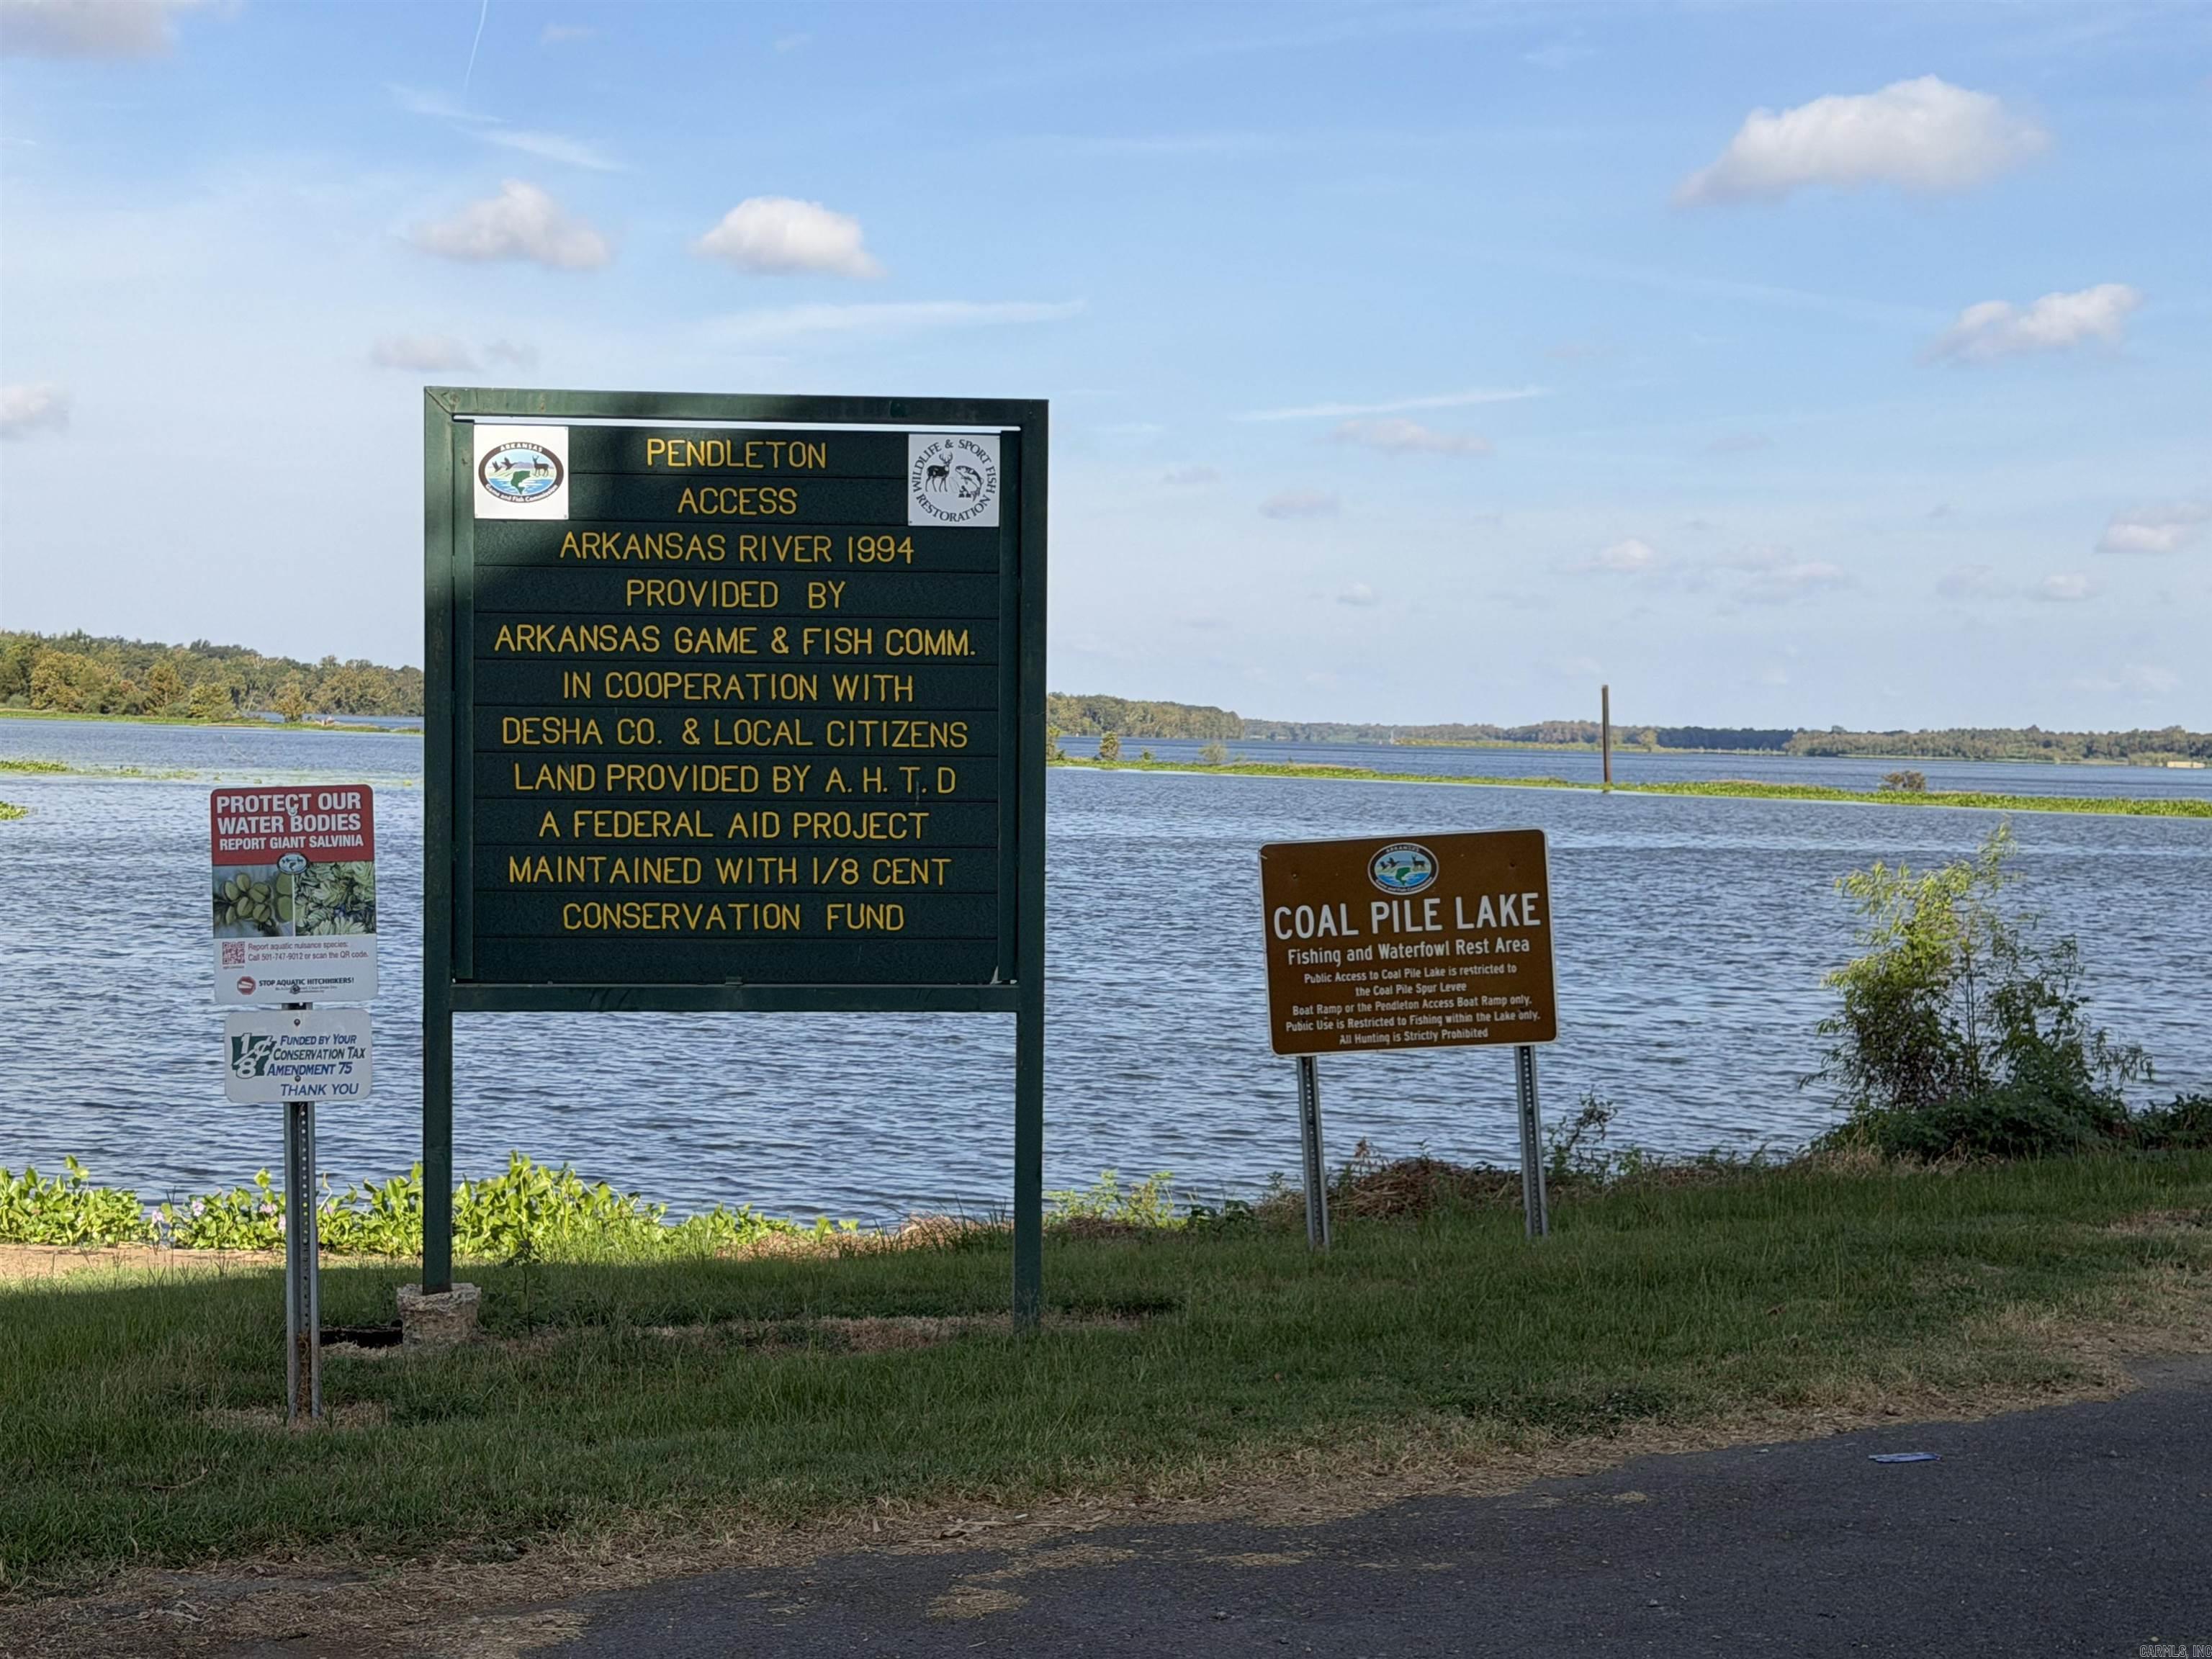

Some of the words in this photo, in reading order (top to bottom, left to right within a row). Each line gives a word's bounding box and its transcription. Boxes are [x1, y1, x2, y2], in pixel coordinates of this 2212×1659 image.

[500, 442, 544, 452] ARKANSAS
[647, 438, 827, 469] PENDLETON
[912, 441, 942, 493] WILDLIFE
[944, 439, 954, 449] &
[958, 439, 992, 464] SPORT
[985, 465, 997, 494] FISH
[678, 487, 798, 516] ACCESS
[916, 493, 991, 522] RESTORATION
[560, 531, 727, 562] ARKANSAS
[739, 535, 832, 564] RIVER
[848, 536, 914, 564] 1994
[626, 579, 779, 608] PROVIDED
[807, 581, 846, 610] BY
[494, 624, 661, 653] ARKANSAS
[673, 626, 757, 655] GAME
[770, 627, 790, 655] &
[802, 627, 873, 655] FISH
[886, 629, 976, 657] COMM.
[563, 672, 591, 699] IN
[605, 672, 818, 701] COOPERATION
[832, 674, 914, 702] WITH
[502, 716, 603, 745] DESHA
[617, 718, 662, 745] CO.
[681, 718, 701, 746] &
[714, 719, 814, 747] LOCAL
[826, 720, 968, 749] CITIZENS
[514, 763, 596, 792] LAND
[606, 764, 760, 793] PROVIDED
[773, 765, 811, 793] BY
[825, 768, 853, 793] A.
[863, 768, 889, 793] H.
[899, 767, 927, 794] T.
[937, 767, 957, 794] D
[217, 793, 312, 814] PROTECT
[318, 792, 361, 811] OUR
[217, 816, 284, 835] WATER
[290, 813, 361, 832] BODIES
[538, 811, 561, 838] A
[573, 810, 714, 839] FEDERAL
[727, 811, 781, 839] AID
[793, 811, 930, 840] PROJECT
[220, 837, 266, 850] REPORT
[269, 836, 306, 849] GIANT
[309, 835, 364, 848] SALVINIA
[508, 855, 703, 884] MAINTAINED
[715, 857, 798, 885] WITH
[812, 858, 860, 886] 1/8
[871, 858, 952, 886] CENT
[562, 902, 801, 931] CONSERVATION
[826, 903, 906, 932] FUND
[1273, 903, 1359, 940] COAL
[1370, 897, 1443, 934] PILE
[1455, 892, 1541, 930] LAKE
[270, 942, 293, 950] aquatic
[1287, 947, 1341, 968] Fishing
[1346, 945, 1373, 962] and
[1377, 940, 1450, 960] Waterfowl
[1455, 938, 1490, 956] Rest
[1495, 936, 1530, 954] Area
[1303, 973, 1332, 984] Public
[1335, 971, 1367, 982] Access
[1370, 970, 1379, 980] to
[1381, 969, 1401, 979] Coal
[1404, 967, 1421, 979] Pile
[1424, 966, 1445, 978] Lake
[1448, 966, 1457, 976] is
[1459, 964, 1505, 976] restricted
[1507, 963, 1517, 974] to
[1355, 986, 1370, 997] the
[1372, 985, 1393, 996] Coal
[1395, 984, 1413, 994] Pile
[1416, 982, 1437, 995] Spur
[1439, 981, 1467, 993] Levee
[1292, 1005, 1313, 1016] Boat
[1316, 1004, 1342, 1015] Ramp
[1357, 1002, 1372, 1012] the
[1375, 999, 1419, 1011] Pendleton
[1422, 999, 1455, 1009] Access
[1457, 997, 1479, 1007] Boat
[1481, 995, 1508, 1007] Ramp
[1510, 994, 1532, 1005] only.
[1285, 1021, 1314, 1032] Public
[1316, 1020, 1334, 1030] Use
[1336, 1019, 1345, 1029] is
[1347, 1017, 1395, 1028] Restricted
[1397, 1016, 1406, 1026] to
[1409, 1014, 1442, 1027] Fishing
[1445, 1012, 1473, 1023] within
[1476, 1012, 1491, 1022] the
[1494, 1011, 1516, 1021] Lake
[1518, 1010, 1541, 1021] only.
[279, 1035, 317, 1046] FUNDED
[318, 1035, 331, 1045] BY
[333, 1033, 357, 1044] YOUR
[1339, 1034, 1352, 1045] All
[1354, 1033, 1390, 1045] Hunting
[1393, 1031, 1401, 1042] is
[1404, 1030, 1438, 1042] Strictly
[1441, 1028, 1488, 1040] Prohibited
[273, 1048, 346, 1061] CONSERVATION
[347, 1046, 366, 1059] TAX
[266, 1063, 336, 1076] AMENDMENT
[338, 1061, 353, 1075] 75
[280, 1083, 328, 1097] THANK
[331, 1082, 359, 1095] YOU
